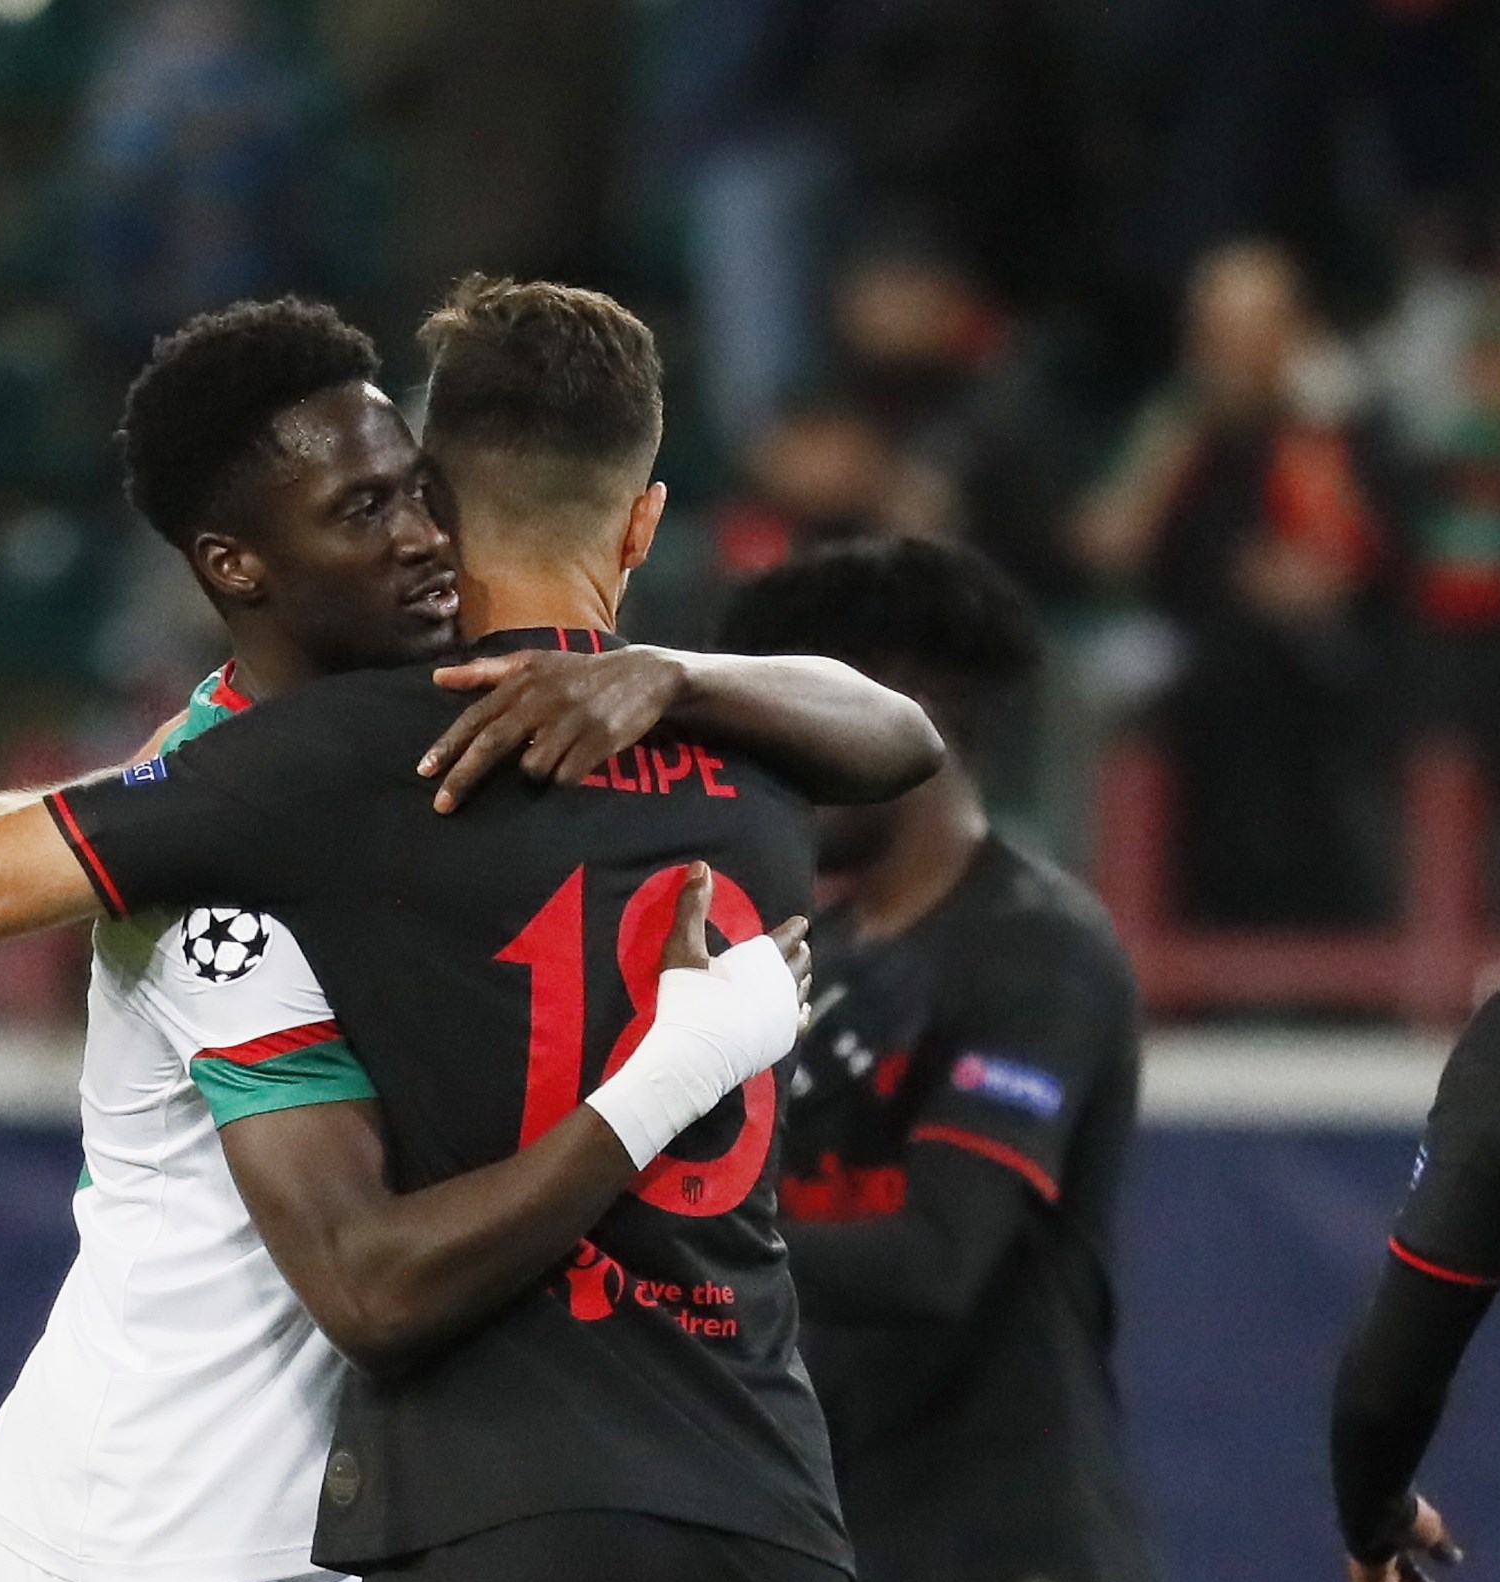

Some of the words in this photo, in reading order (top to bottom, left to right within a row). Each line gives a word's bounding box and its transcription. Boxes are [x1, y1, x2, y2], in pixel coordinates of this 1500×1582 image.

[581, 742, 739, 799] LIPE
[492, 862, 776, 1218] 18
[692, 1279, 736, 1305] the
